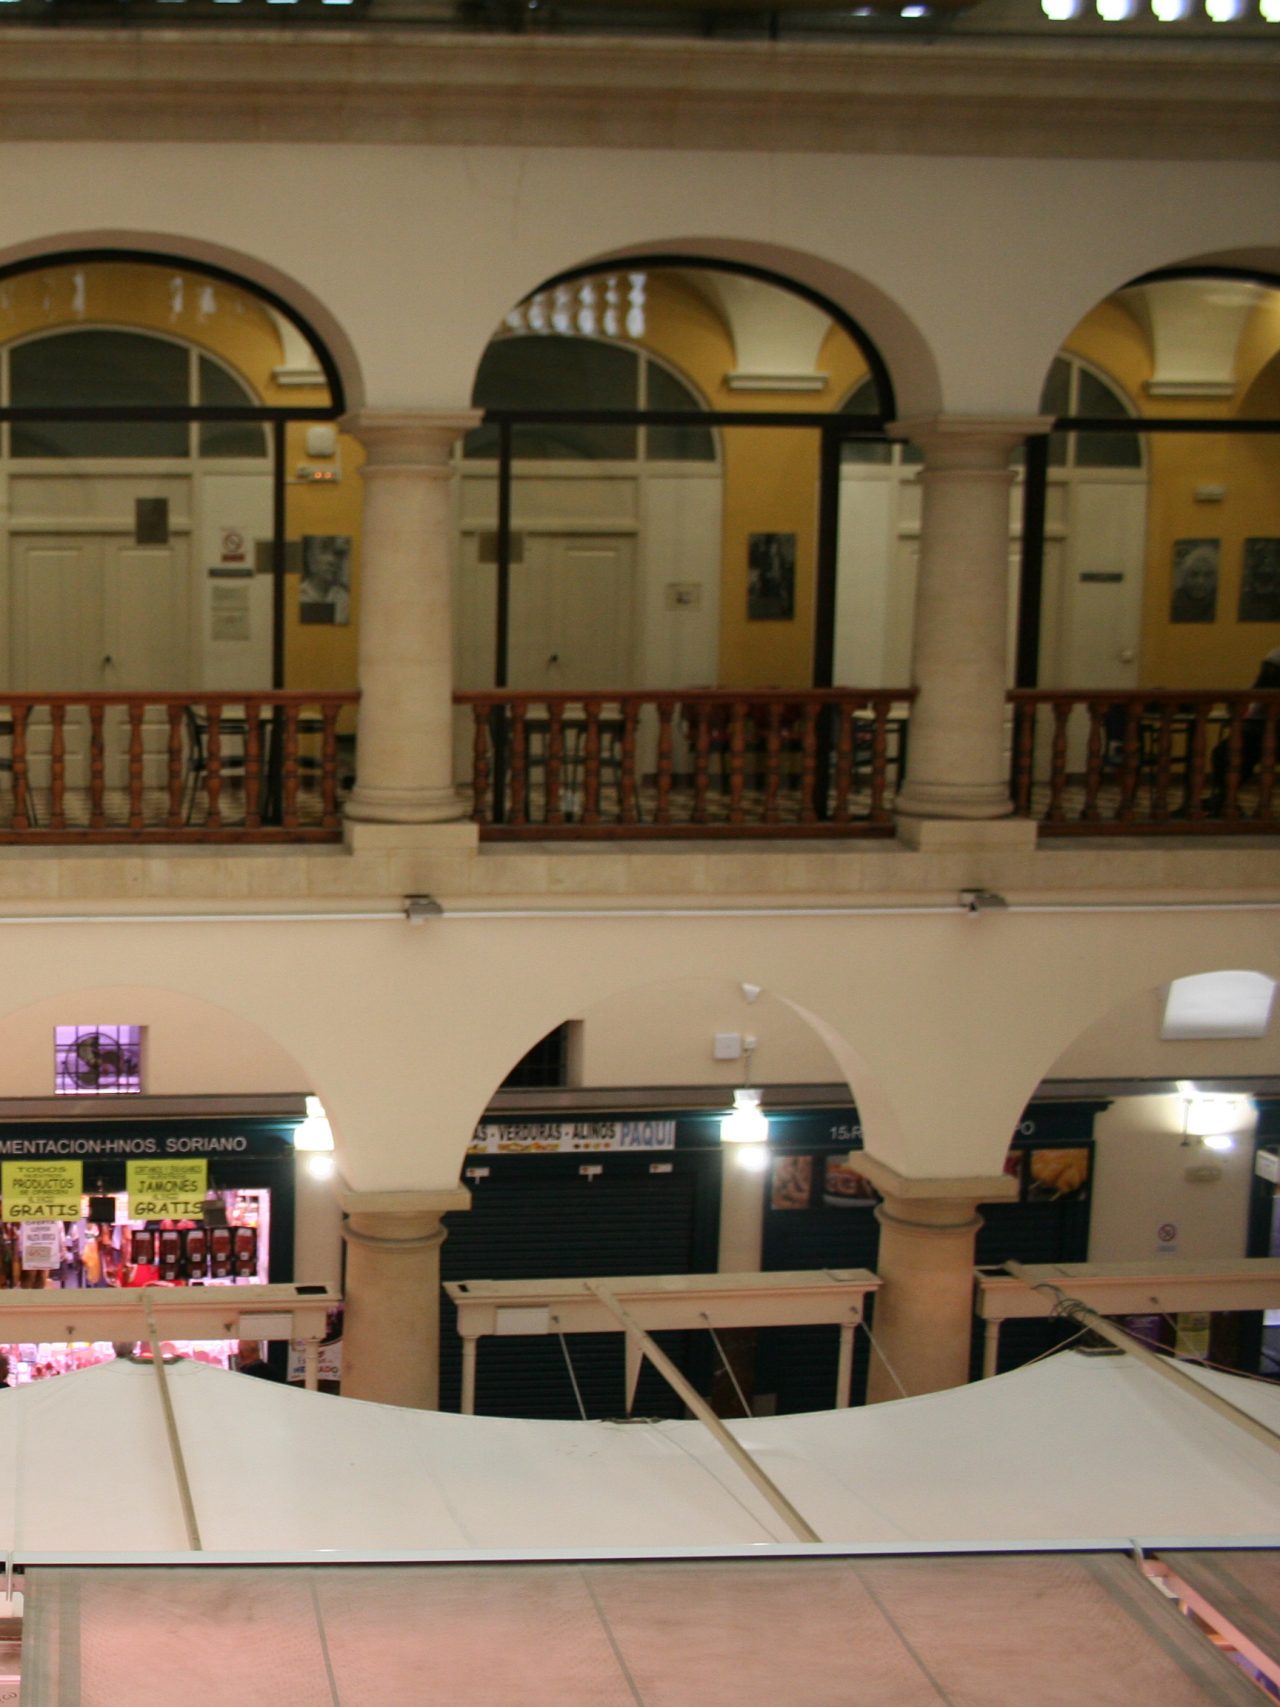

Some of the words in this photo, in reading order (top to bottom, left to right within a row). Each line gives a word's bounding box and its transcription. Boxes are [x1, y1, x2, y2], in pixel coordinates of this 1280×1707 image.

[620, 1121, 672, 1146] PAQUI
[166, 1137, 247, 1153] SORIANO
[12, 1178, 75, 1189] PRODUCTOS
[137, 1180, 198, 1193] JAMONES
[9, 1204, 79, 1217] GRATIS
[135, 1201, 204, 1216] GRATIS
